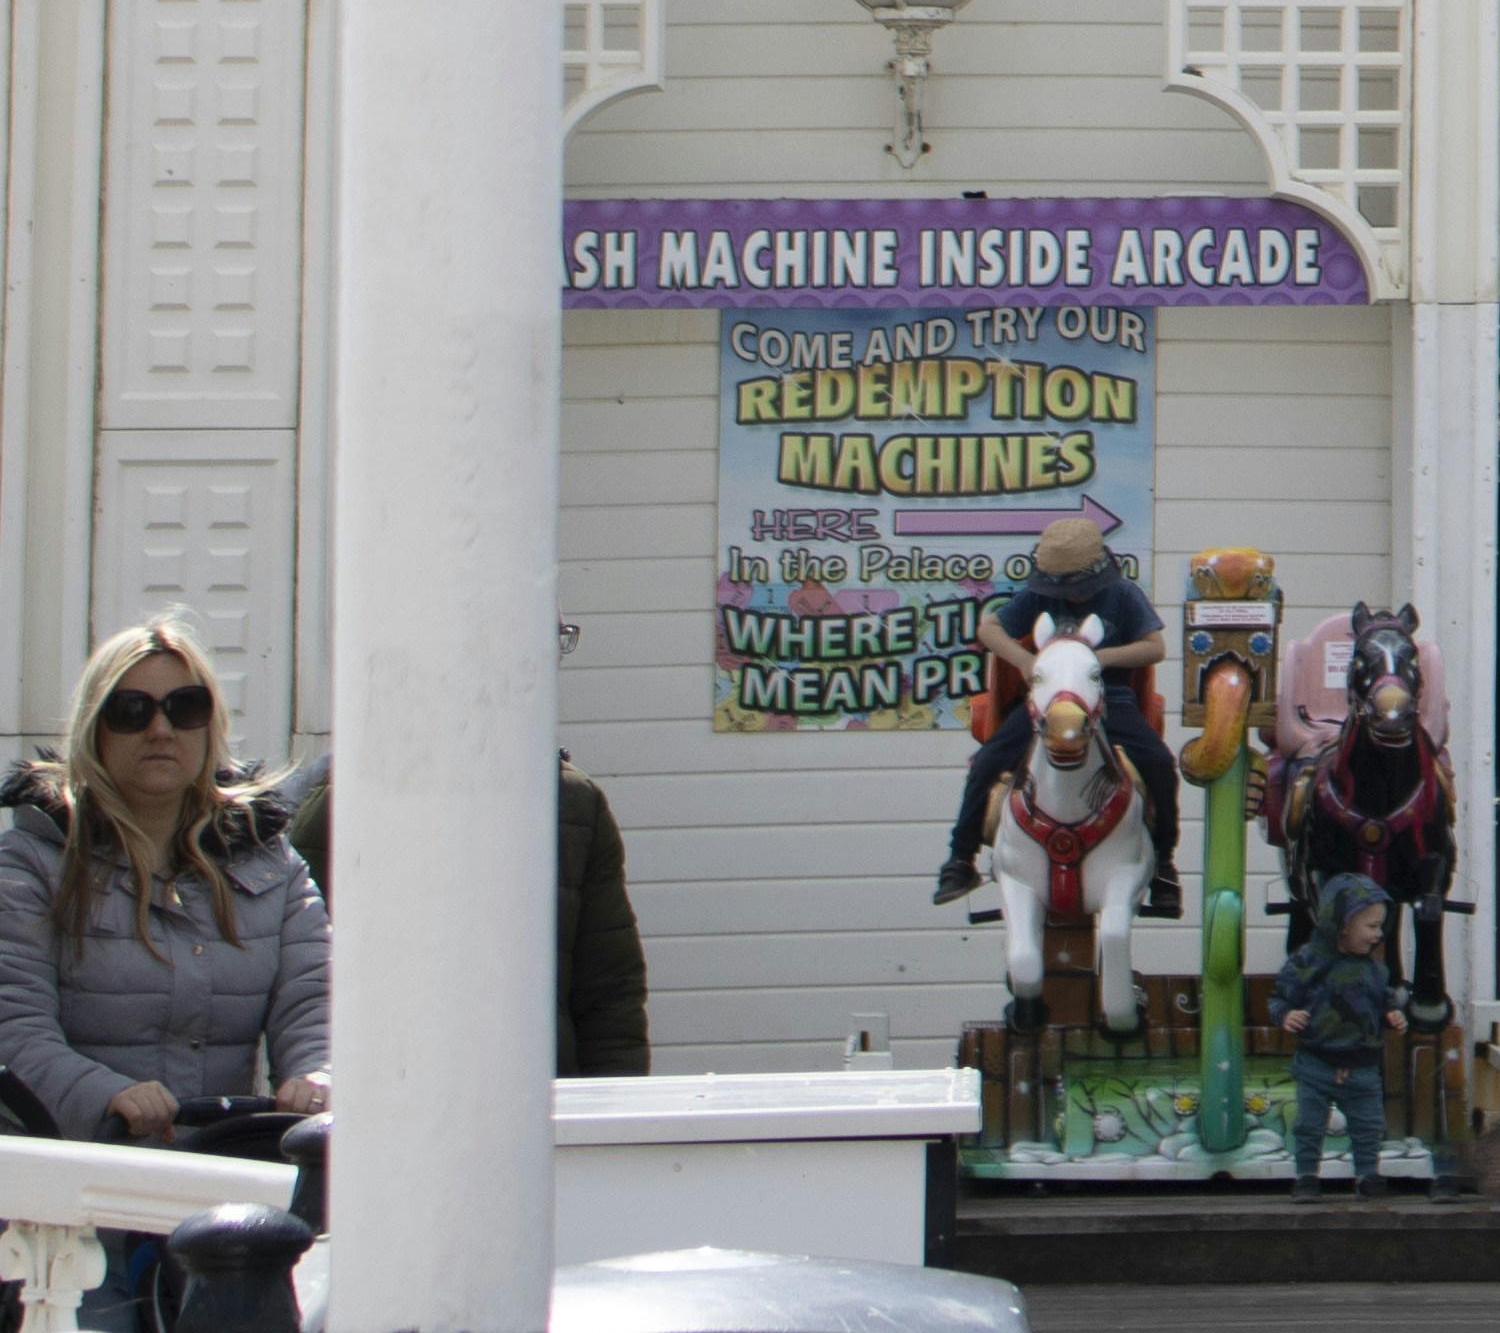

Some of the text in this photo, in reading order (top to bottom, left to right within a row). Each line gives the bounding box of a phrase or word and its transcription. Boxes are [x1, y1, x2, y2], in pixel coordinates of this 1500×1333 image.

[563, 227, 1322, 290] SH MACHINE INSIDE ARCADE
[731, 306, 1147, 369] COME AND TRY OUR
[736, 356, 1137, 424] REDEMPTION
[777, 431, 1096, 498] MACHINES
[752, 509, 880, 542] HERE
[728, 546, 1039, 583] In the Palace o
[722, 606, 918, 661] WHERE
[739, 648, 995, 714] MEAN PRI
